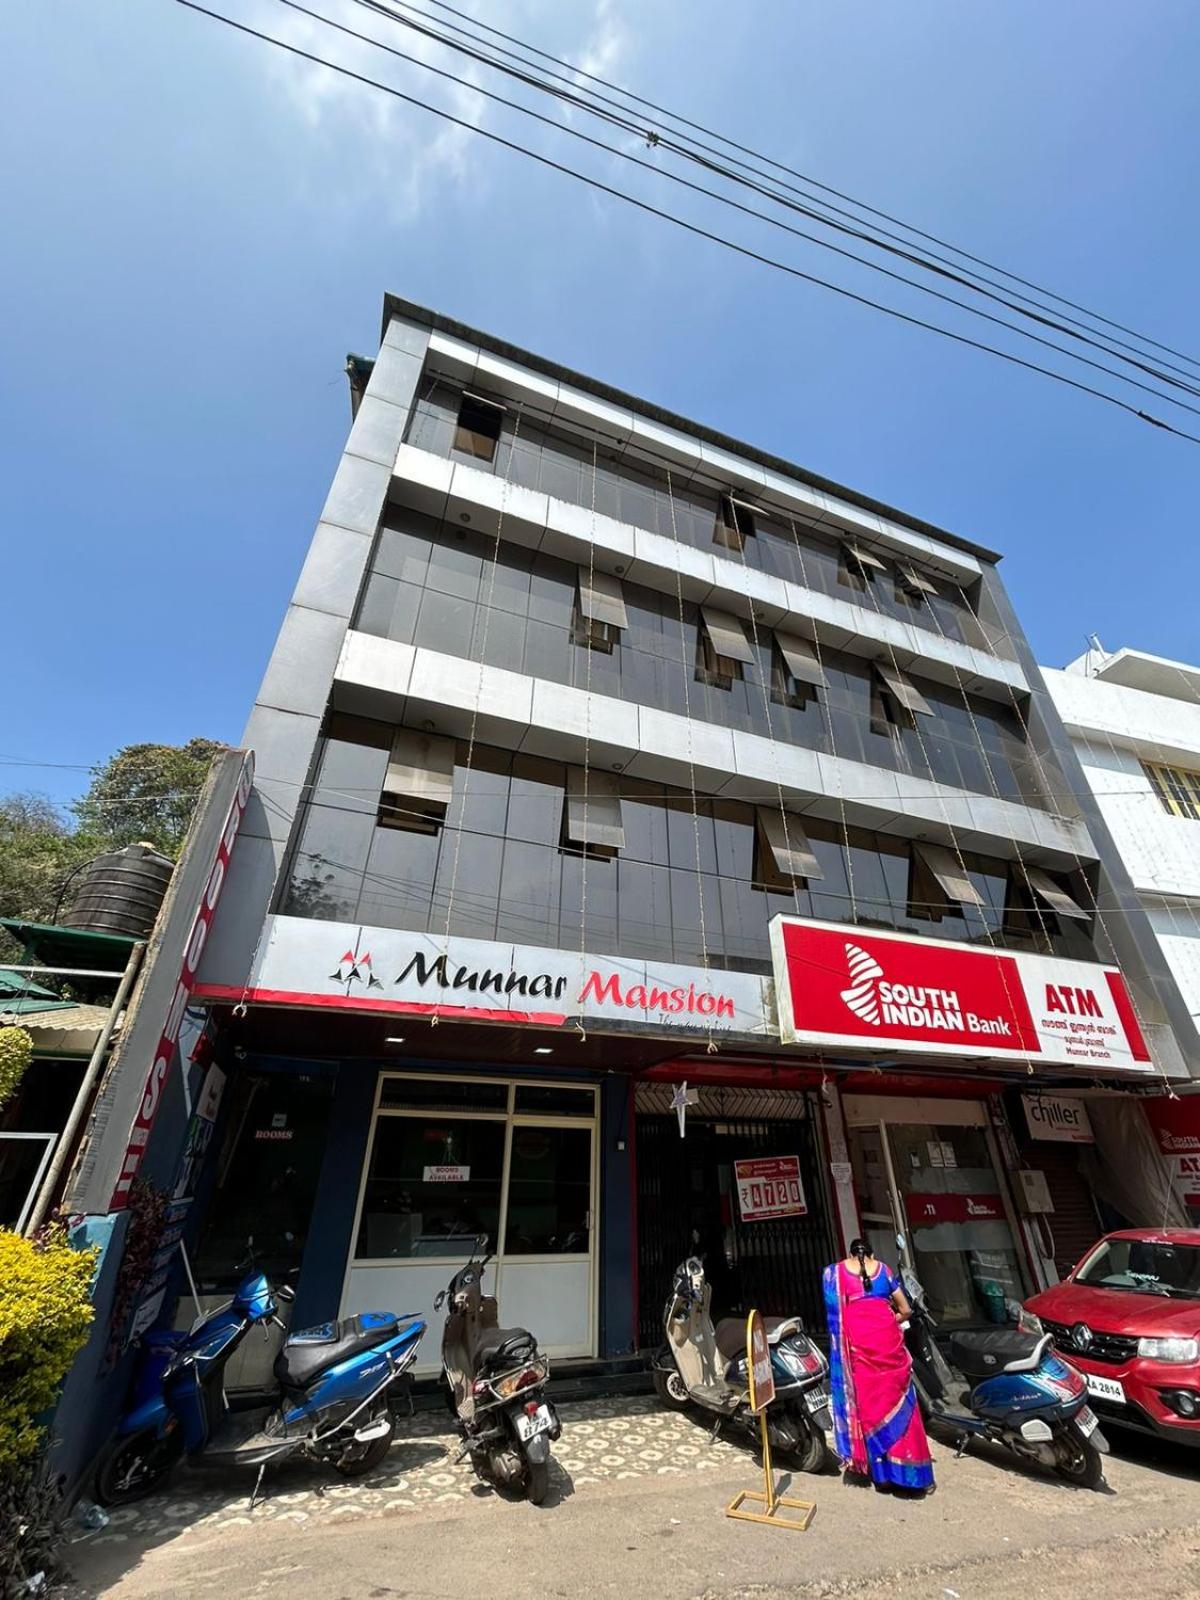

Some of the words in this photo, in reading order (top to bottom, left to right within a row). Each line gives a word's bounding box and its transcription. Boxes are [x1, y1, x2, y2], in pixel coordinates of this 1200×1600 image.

[143, 803, 241, 1121] ROOMS
[394, 951, 568, 999] Munnar
[577, 970, 736, 1019] Mansion
[878, 980, 961, 1011] SOUTH
[1045, 983, 1104, 1018] ATM
[880, 1003, 966, 1032] INDIAN
[966, 1012, 1012, 1037] Bank
[1066, 1047, 1089, 1056] Munnar
[1090, 1049, 1111, 1058] Branch
[1031, 1099, 1080, 1128] chiller
[255, 1130, 293, 1140] ROOMS
[1099, 1382, 1121, 1397] 2814
